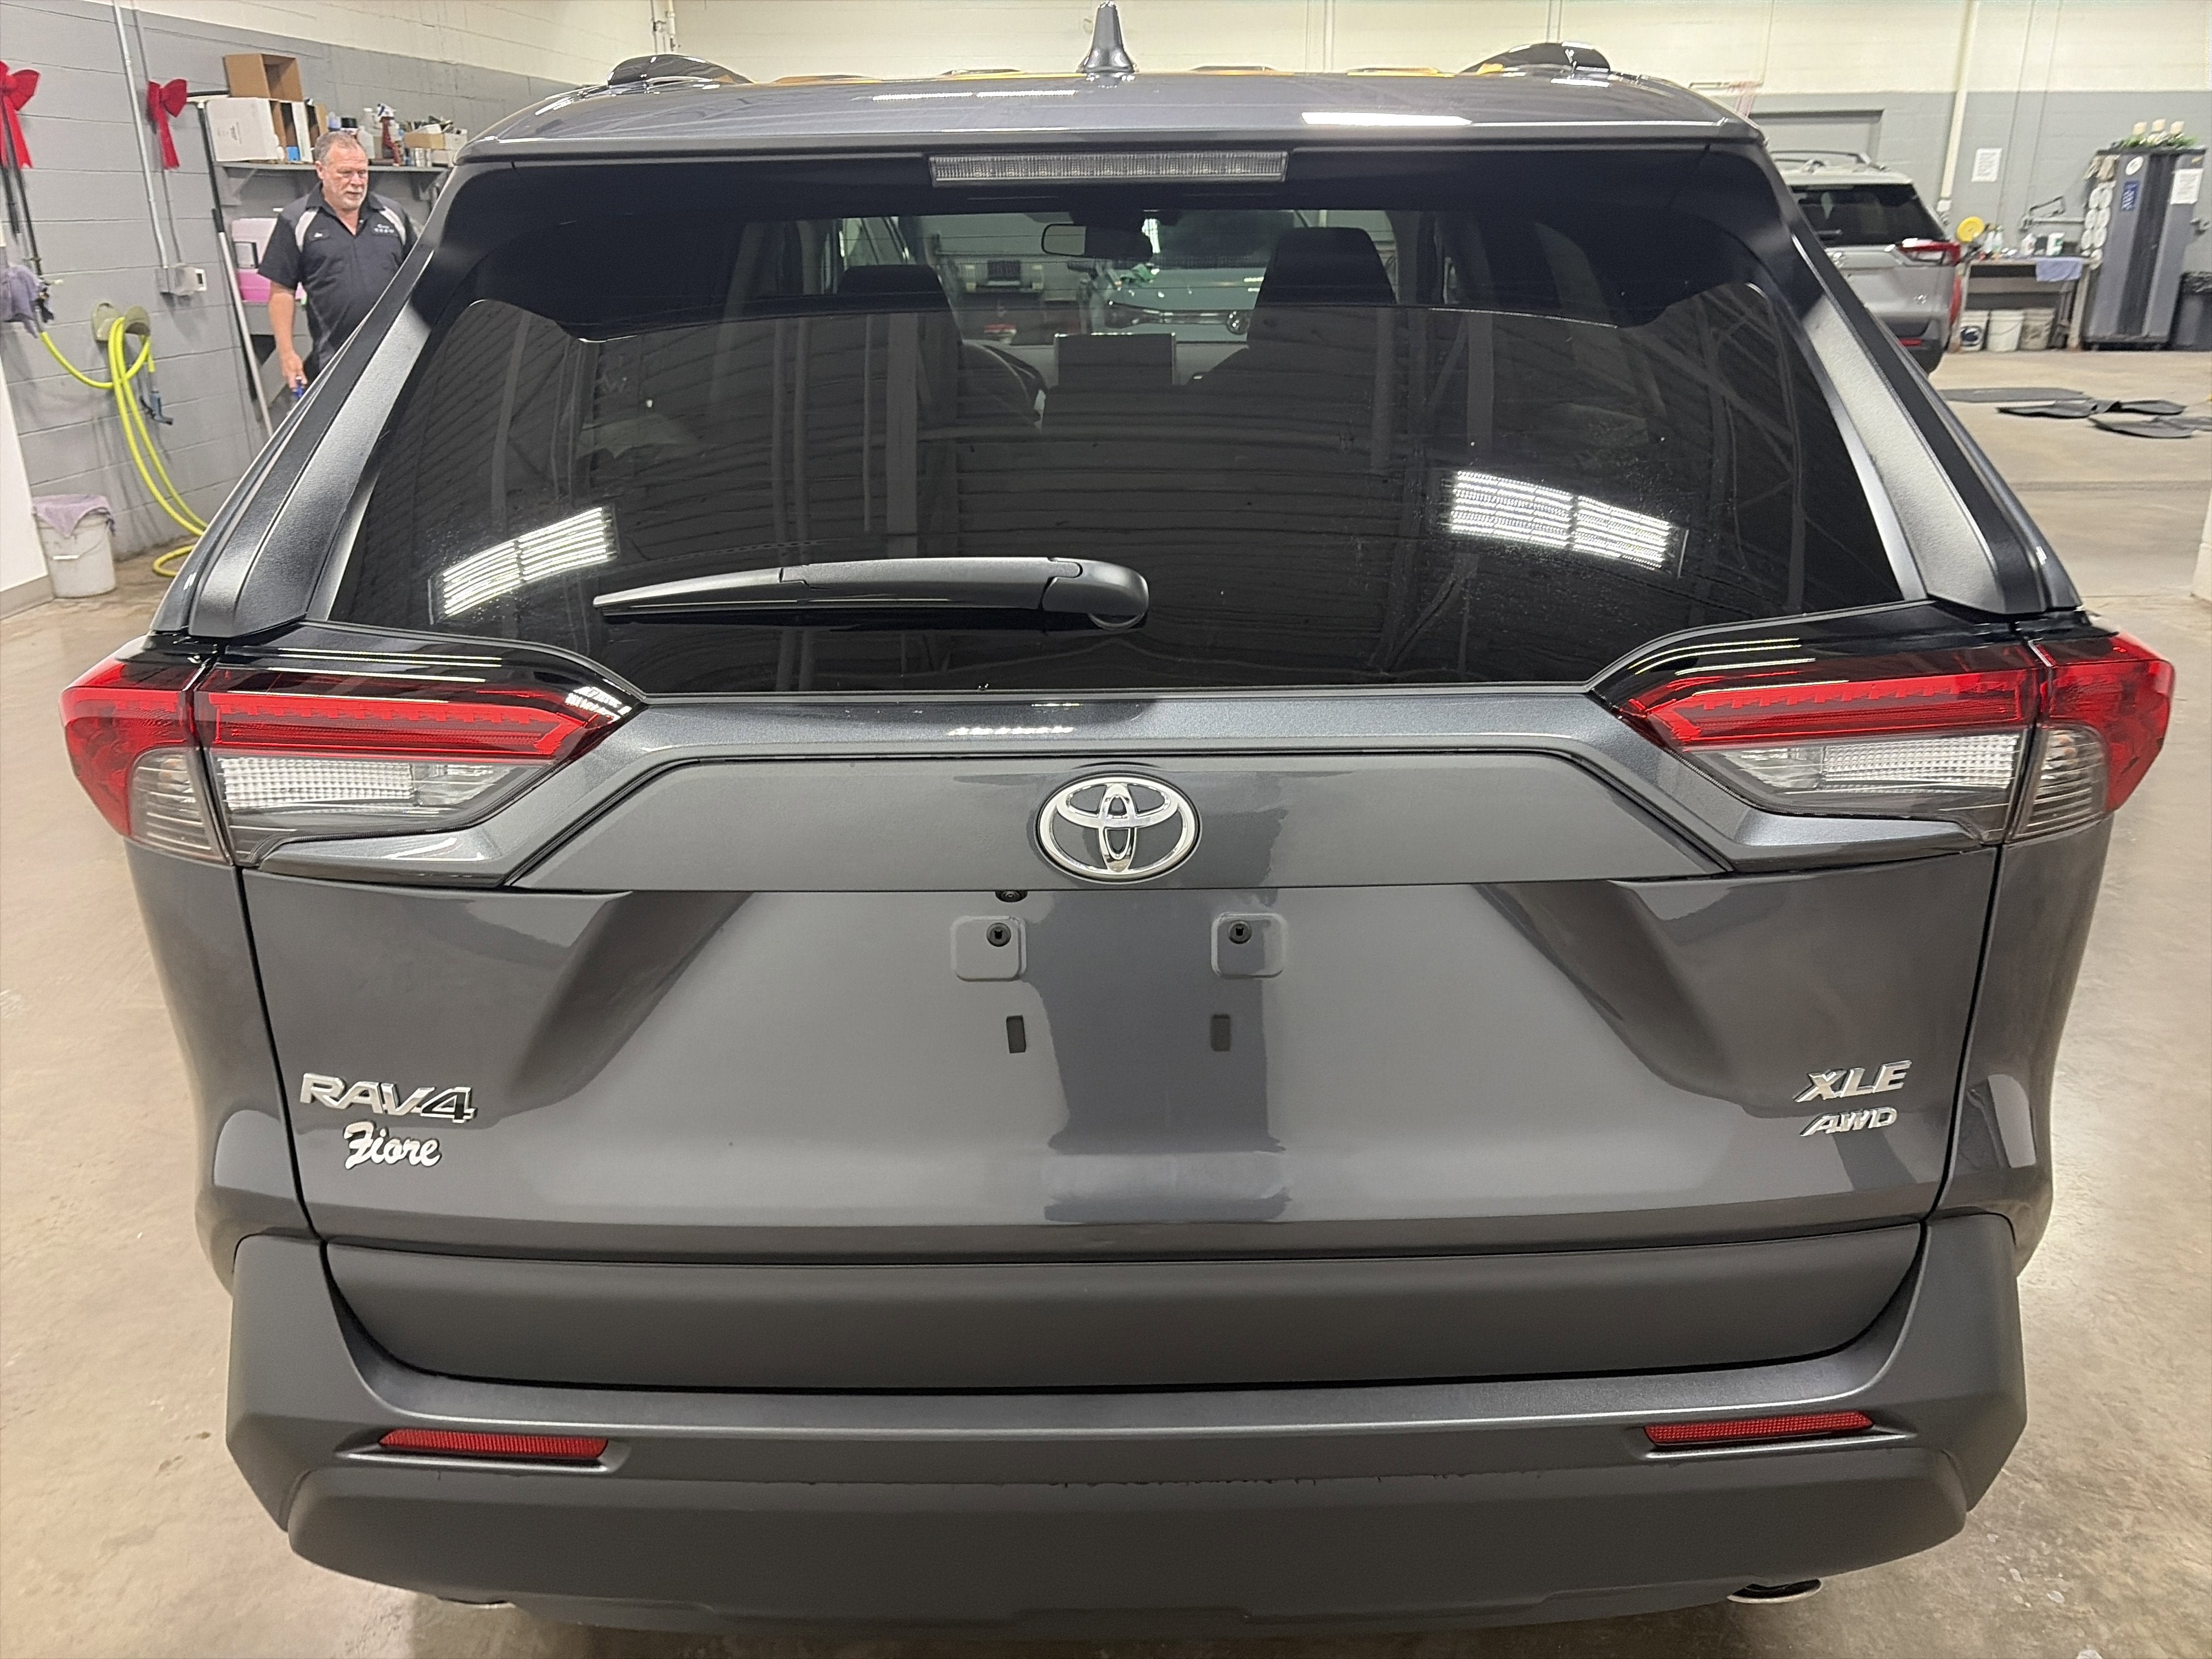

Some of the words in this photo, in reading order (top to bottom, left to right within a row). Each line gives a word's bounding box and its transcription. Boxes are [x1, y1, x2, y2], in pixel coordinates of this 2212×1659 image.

[300, 1073, 477, 1123] RAV4
[1793, 1060, 1912, 1102] XLE
[1799, 1106, 1898, 1137] AWD
[343, 1121, 441, 1169] Fiore
